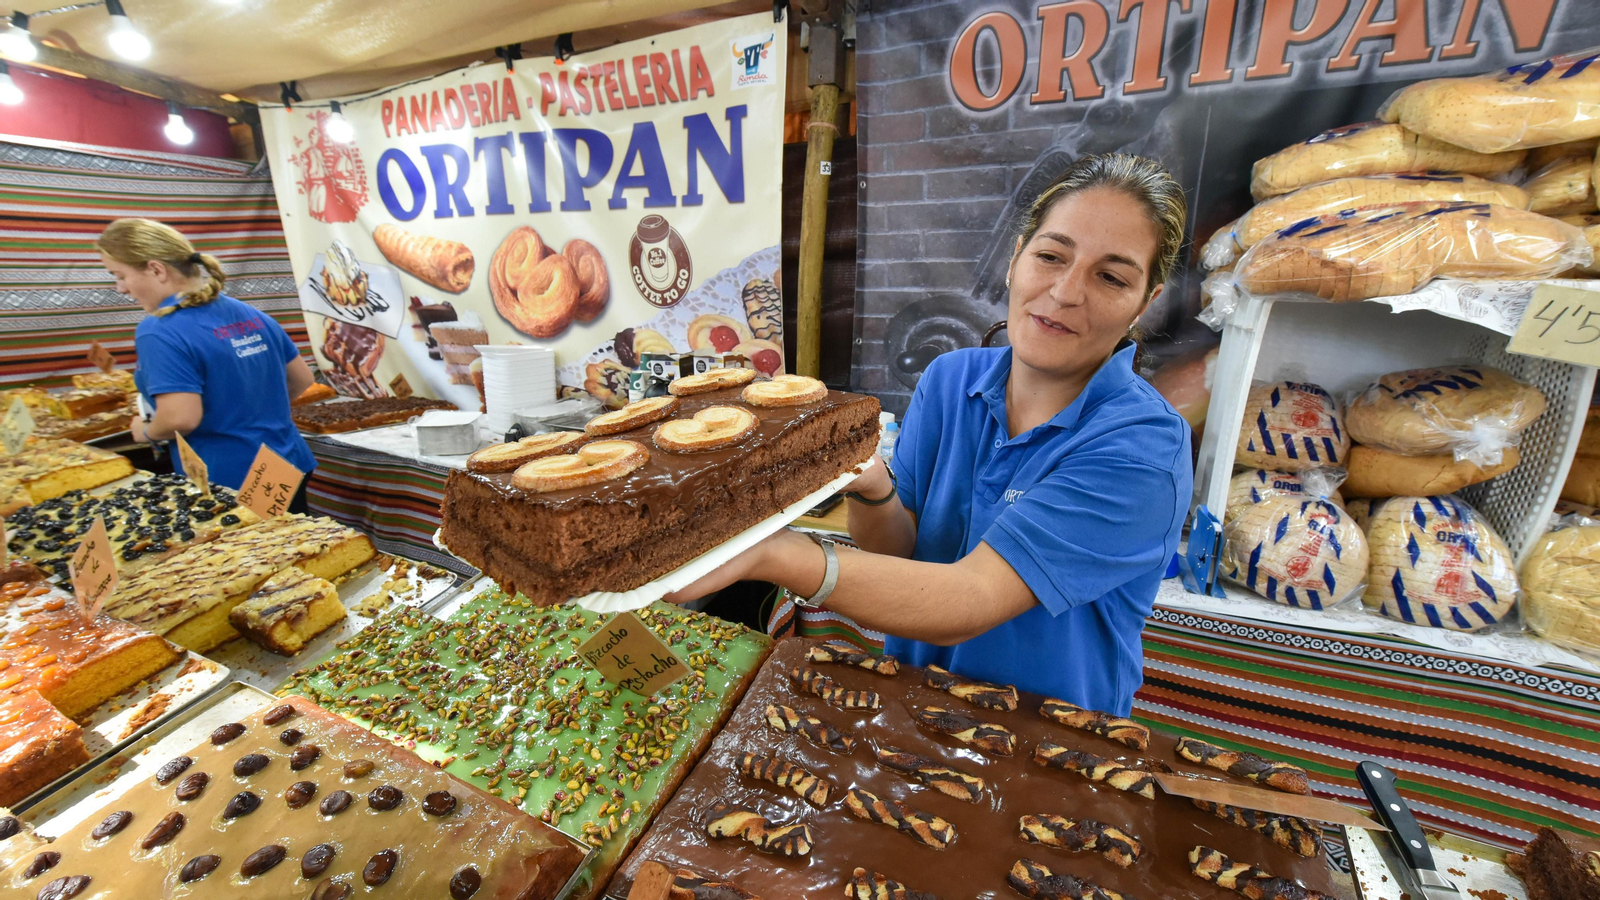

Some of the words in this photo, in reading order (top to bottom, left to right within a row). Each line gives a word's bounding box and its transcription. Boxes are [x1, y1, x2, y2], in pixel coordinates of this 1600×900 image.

[949, 0, 1558, 112] ORTIPAN
[381, 77, 521, 138] PANADERIA
[538, 45, 715, 116] PASTELERIA
[737, 71, 768, 84] Ronda
[376, 104, 749, 221] ORTIPAN
[632, 265, 663, 304] COFFEE
[663, 288, 679, 304] TO
[676, 268, 690, 290] GO
[238, 462, 268, 507] Bizcocho
[262, 482, 276, 498] de
[1004, 489, 1025, 503] ORT
[584, 628, 628, 667] Bizcocho
[612, 654, 636, 670] de
